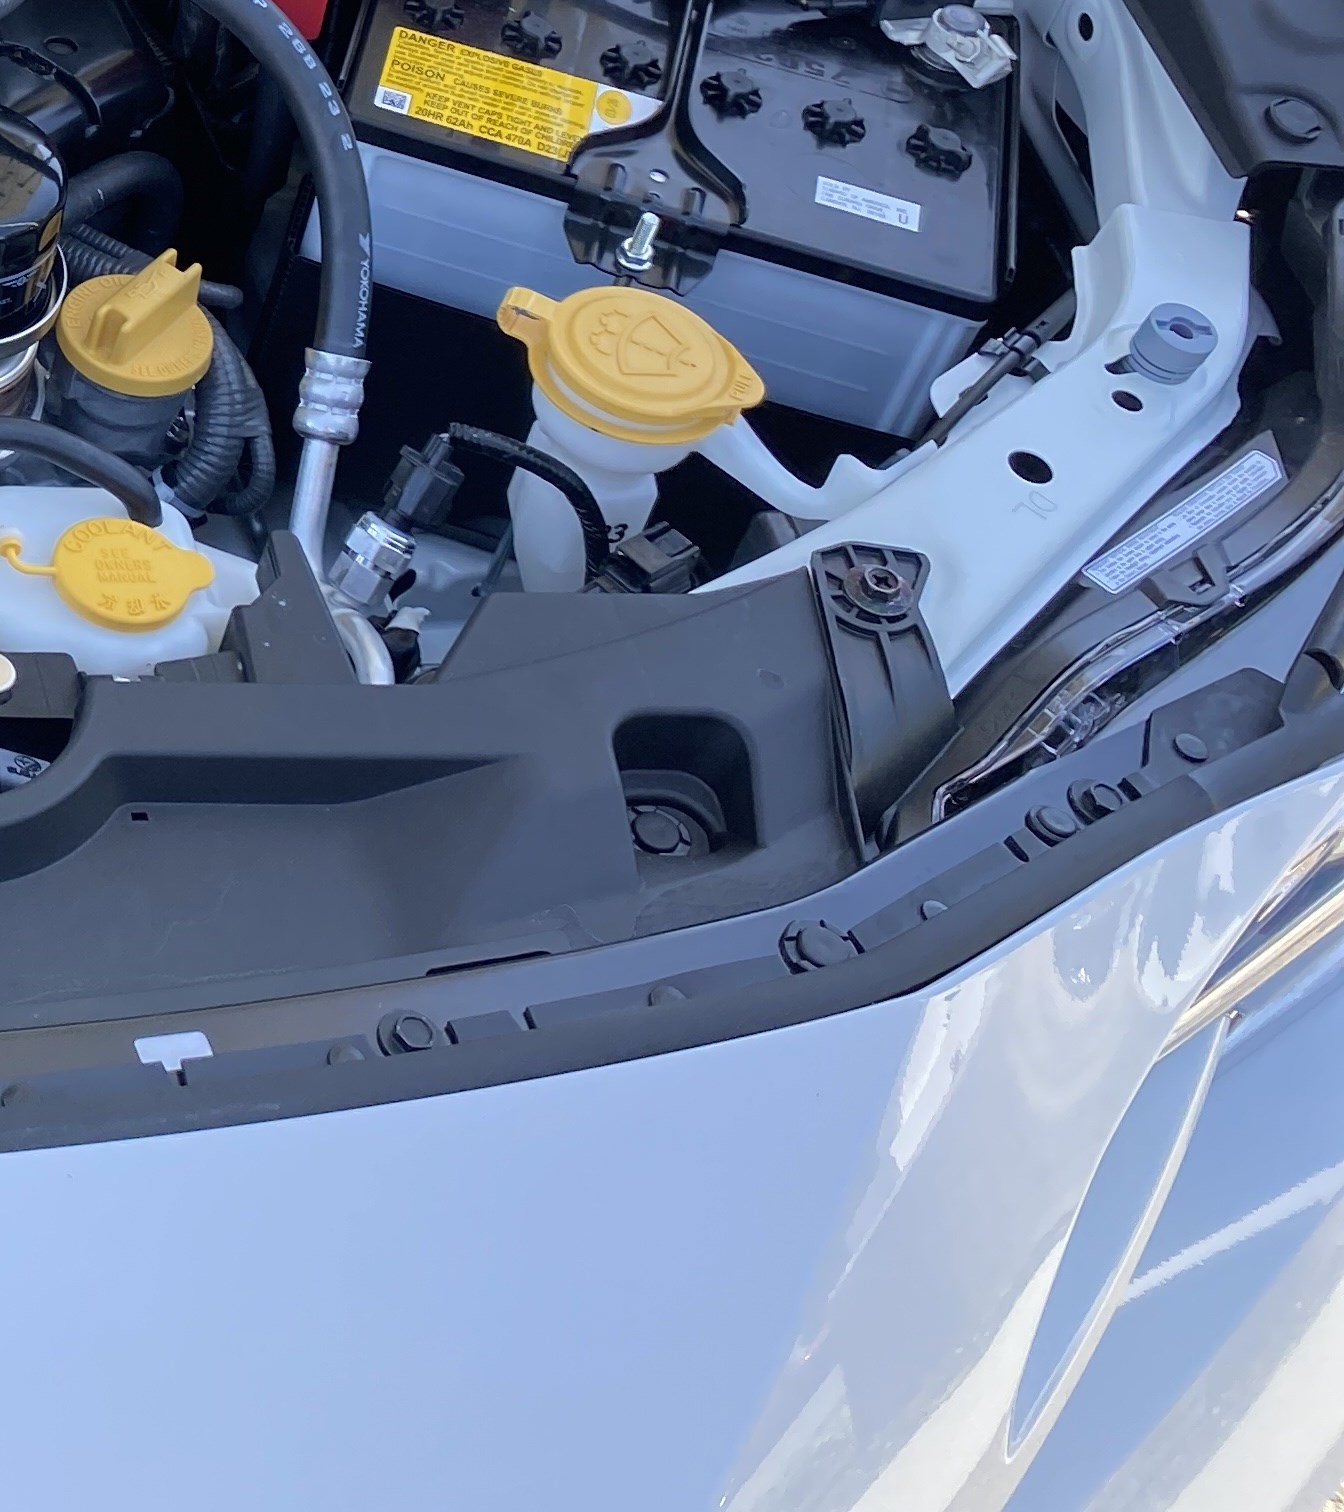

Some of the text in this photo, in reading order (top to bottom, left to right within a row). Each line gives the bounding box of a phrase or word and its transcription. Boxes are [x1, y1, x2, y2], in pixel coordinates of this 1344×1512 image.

[398, 29, 456, 54] DANGER
[461, 48, 511, 69] EXPLOSIVE
[391, 59, 446, 82] POISON
[453, 77, 491, 94] CAUSES
[492, 89, 528, 105] SEVERE
[318, 81, 342, 117] 23
[340, 133, 353, 151] 2
[414, 105, 444, 122] 20HR
[445, 115, 474, 131] 62Ah
[478, 125, 503, 140] CCA
[505, 133, 533, 148] 470A
[423, 99, 448, 111] KEEP
[450, 106, 470, 118] OUT
[470, 111, 484, 121] OF
[486, 117, 519, 131] REACH
[520, 125, 534, 136] OF
[425, 91, 580, 143] KEEP VENT CAPS TIGHT AND LEVE
[65, 280, 99, 330] ENGINE
[352, 257, 370, 349] YOKOHAMA
[729, 374, 752, 402] PULL
[62, 518, 173, 554] COOLANT
[99, 548, 129, 559] SEE
[96, 571, 157, 584] MANUAL
